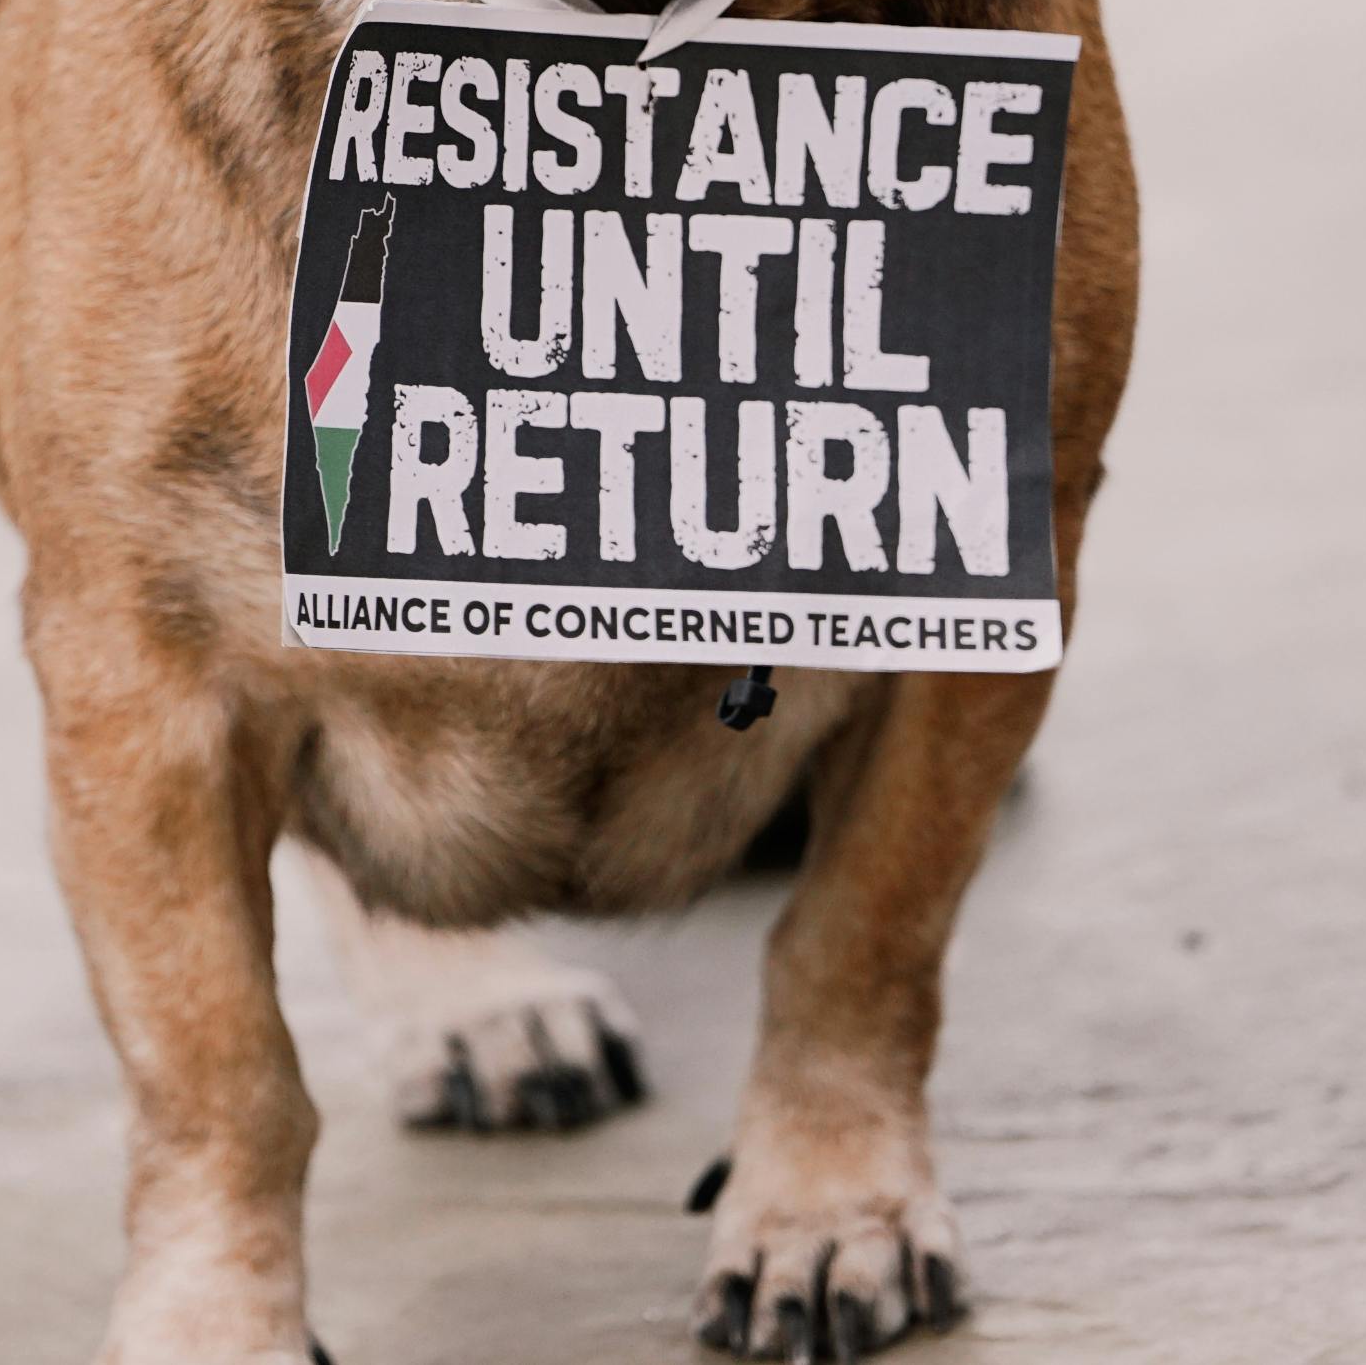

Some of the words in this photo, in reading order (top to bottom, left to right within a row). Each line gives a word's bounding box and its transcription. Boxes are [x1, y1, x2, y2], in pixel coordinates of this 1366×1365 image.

[329, 48, 1042, 216] RESISTANCE
[480, 203, 931, 393] UNTIL
[386, 383, 1011, 577] RETURN
[296, 591, 451, 634] ALLIANCE
[462, 600, 514, 636] OF
[525, 603, 795, 646] CONCERNED
[806, 612, 1038, 651] TEACHERS
